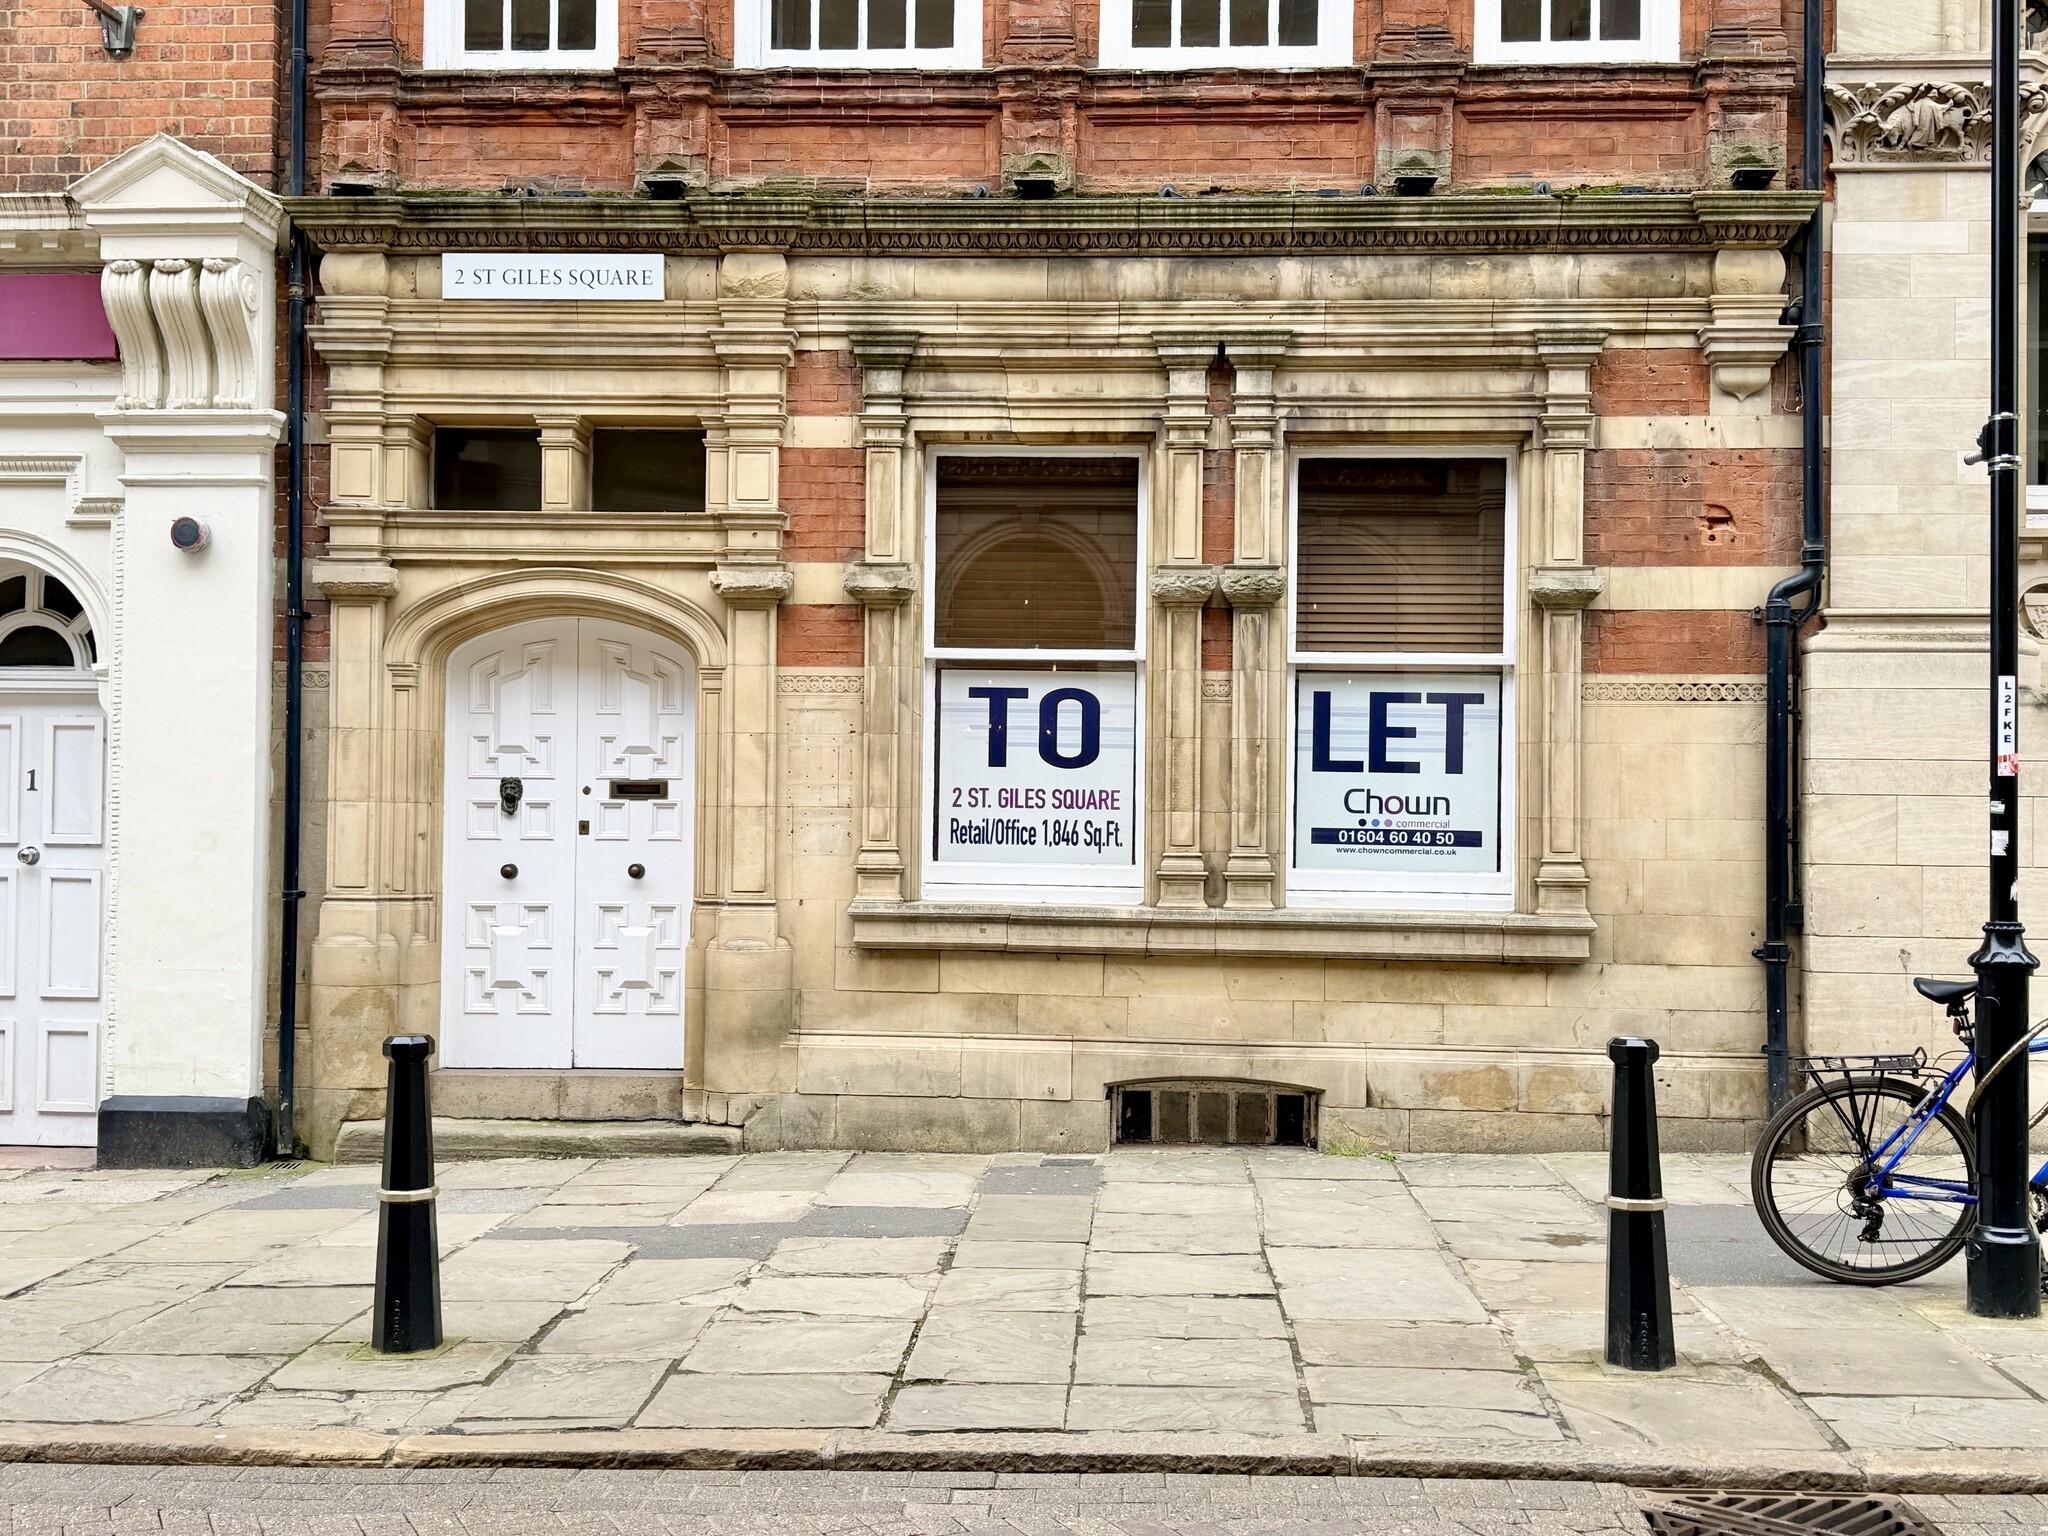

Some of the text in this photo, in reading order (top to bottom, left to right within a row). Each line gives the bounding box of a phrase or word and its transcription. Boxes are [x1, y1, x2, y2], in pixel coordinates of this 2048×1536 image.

[454, 268, 654, 289] 2 ST GILES SQUARE
[968, 686, 1100, 769] TO
[1312, 691, 1485, 774] LET
[26, 769, 38, 791] 1
[952, 787, 1121, 810] 2 ST. GILES SQUARE
[1343, 788, 1450, 816] Chown
[1396, 819, 1450, 829] commercial
[950, 817, 1123, 854] Retail/Office 1,846 Sq.Ft.
[1338, 830, 1455, 845] 01604 60 40 50
[1336, 846, 1457, 856] www.chowncommercial.co.uk
